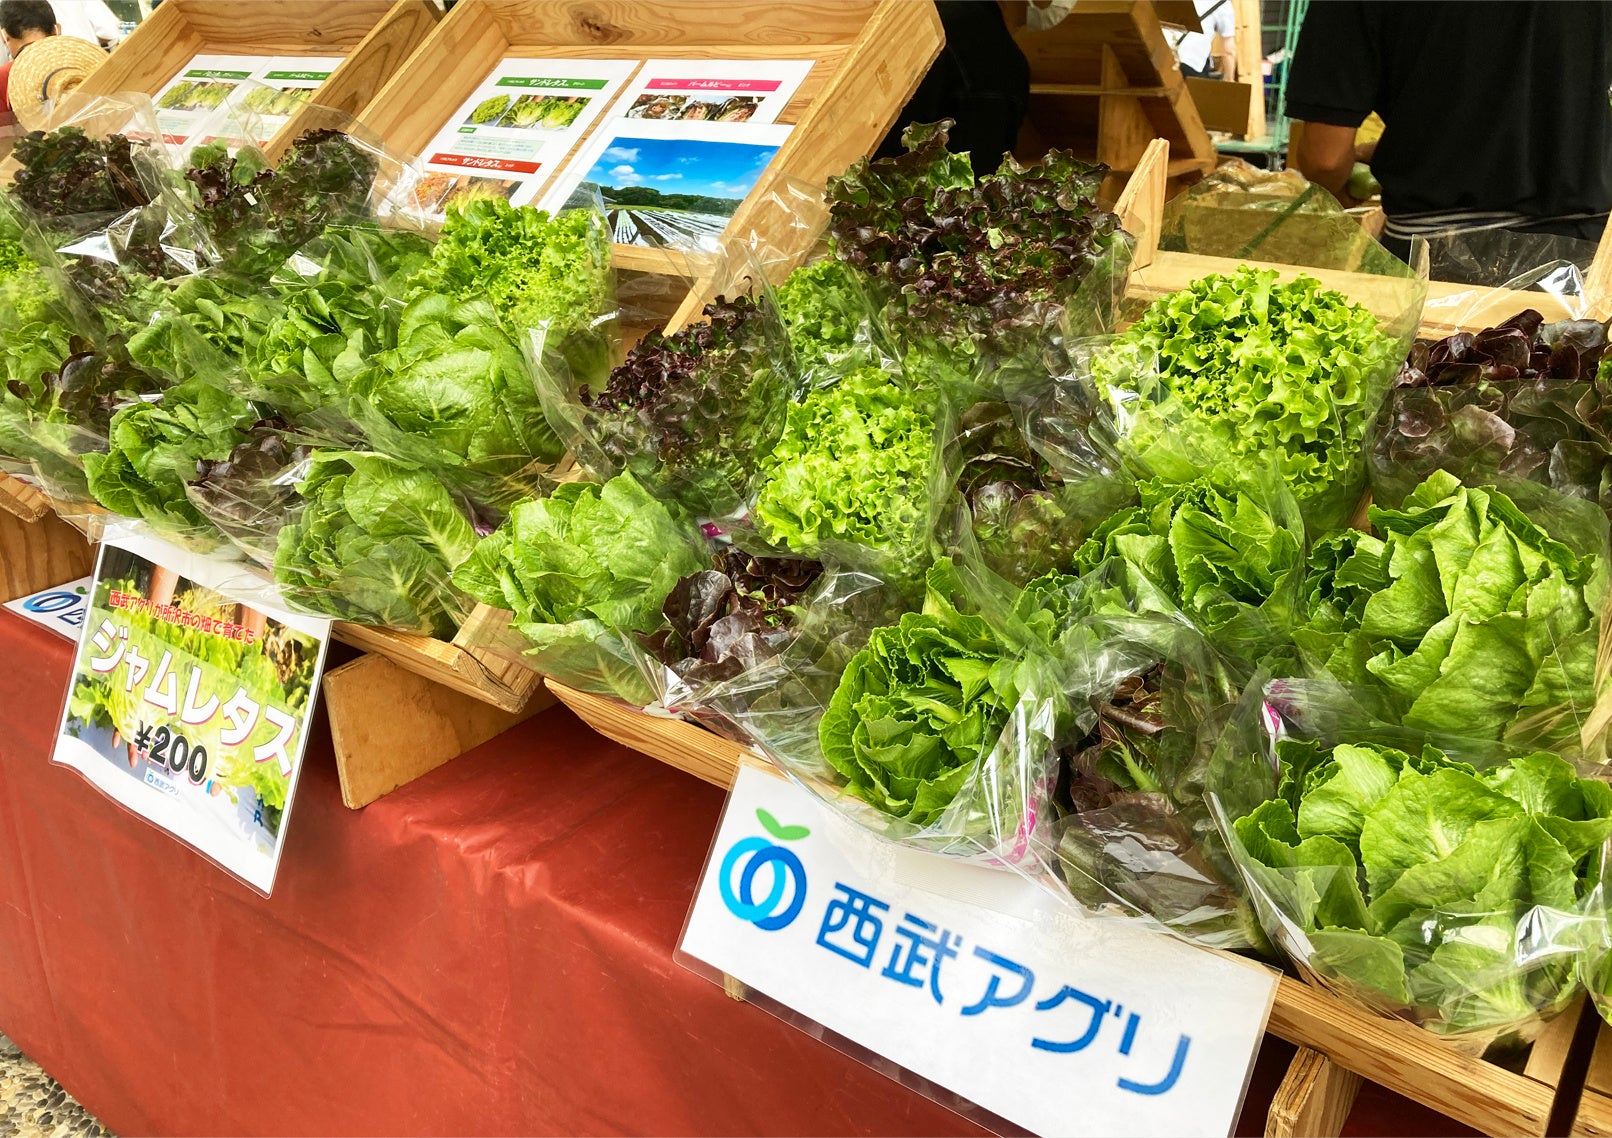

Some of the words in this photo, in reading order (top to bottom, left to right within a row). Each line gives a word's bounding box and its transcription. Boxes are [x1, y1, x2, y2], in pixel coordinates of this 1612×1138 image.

[109, 589, 256, 645] 西武アグリが所沢市の畑で育てた
[91, 618, 296, 778] ジャムレタス
[134, 720, 208, 783] ¥200
[816, 881, 1191, 1096] 西武アグリ
